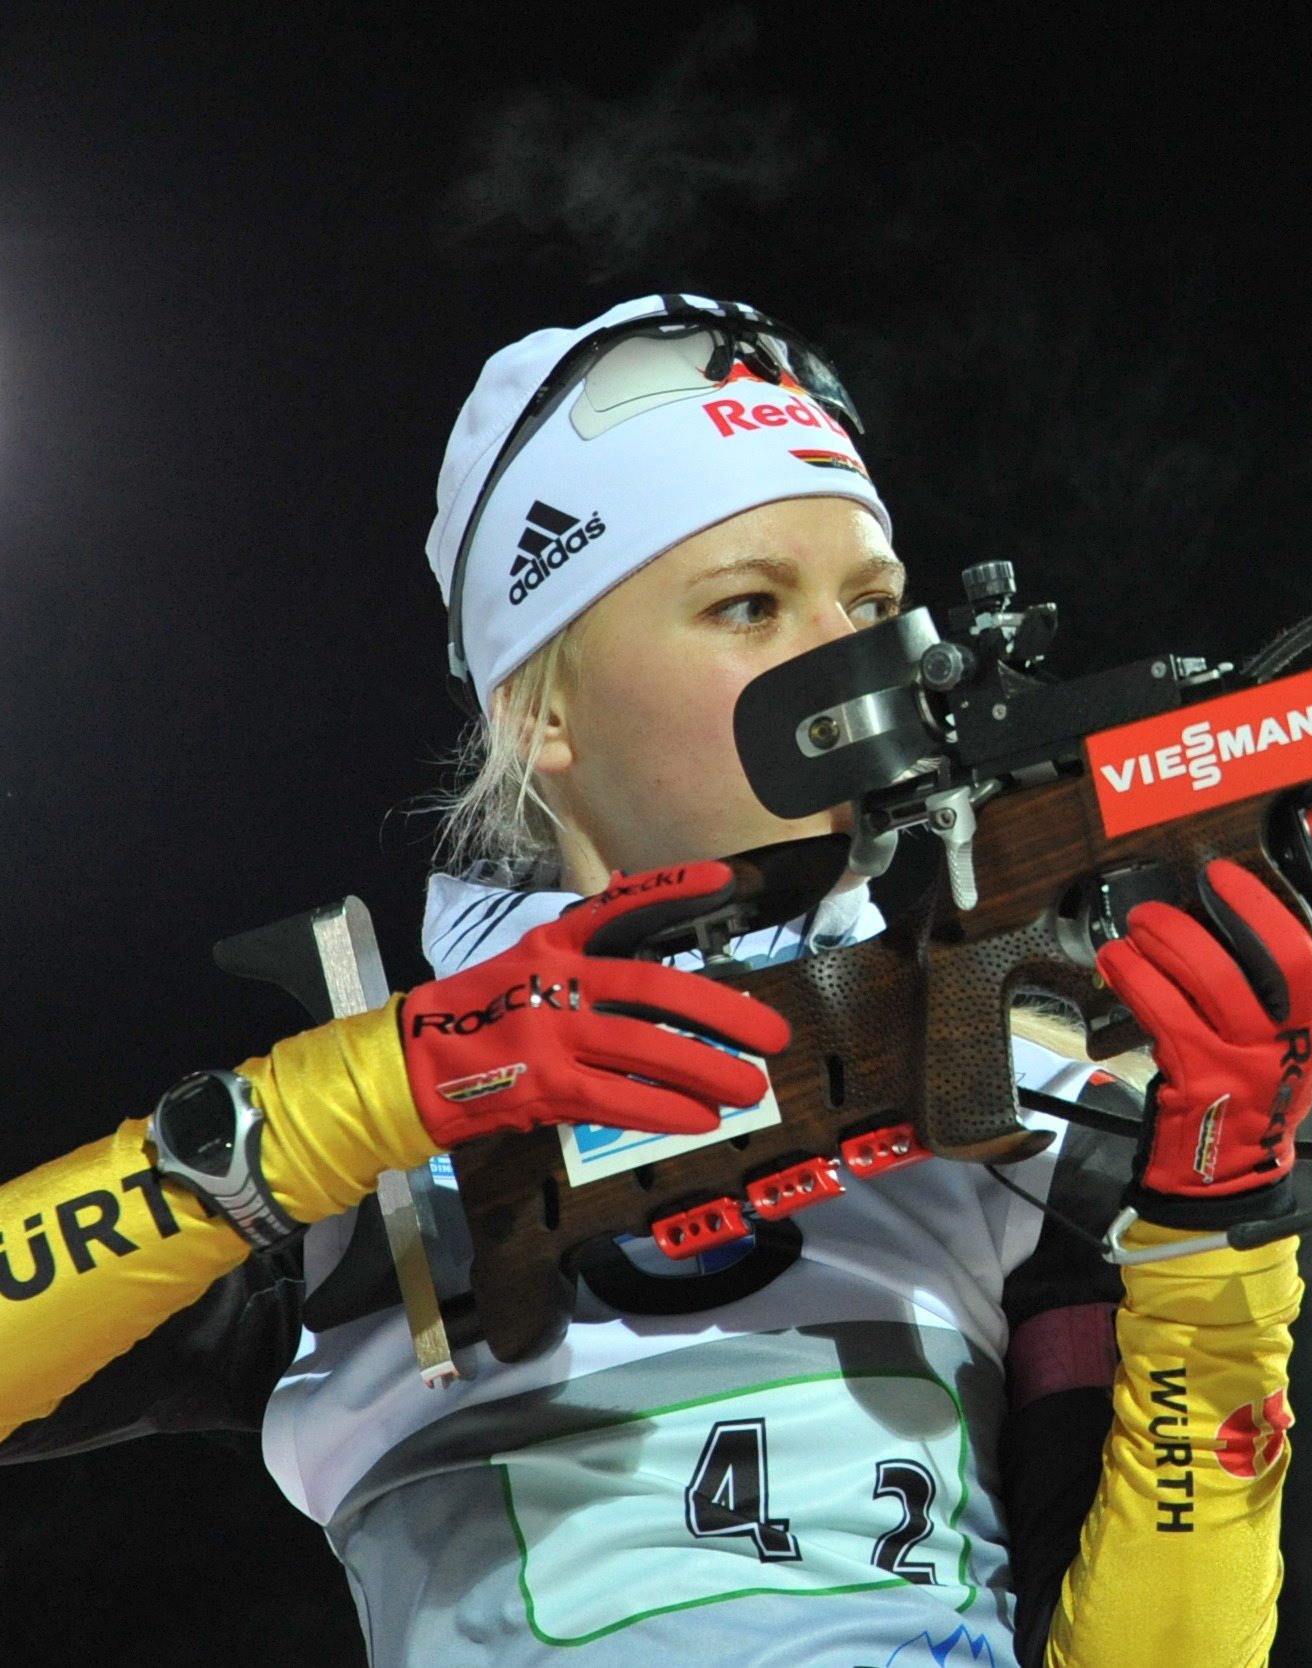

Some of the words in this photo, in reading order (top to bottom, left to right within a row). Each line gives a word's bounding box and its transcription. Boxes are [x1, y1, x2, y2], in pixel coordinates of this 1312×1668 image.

[702, 395, 822, 438] Red
[509, 517, 606, 606] adidas
[684, 1417, 802, 1563] 4
[1149, 1367, 1194, 1534] WÜRTH
[871, 1458, 939, 1586] 2
